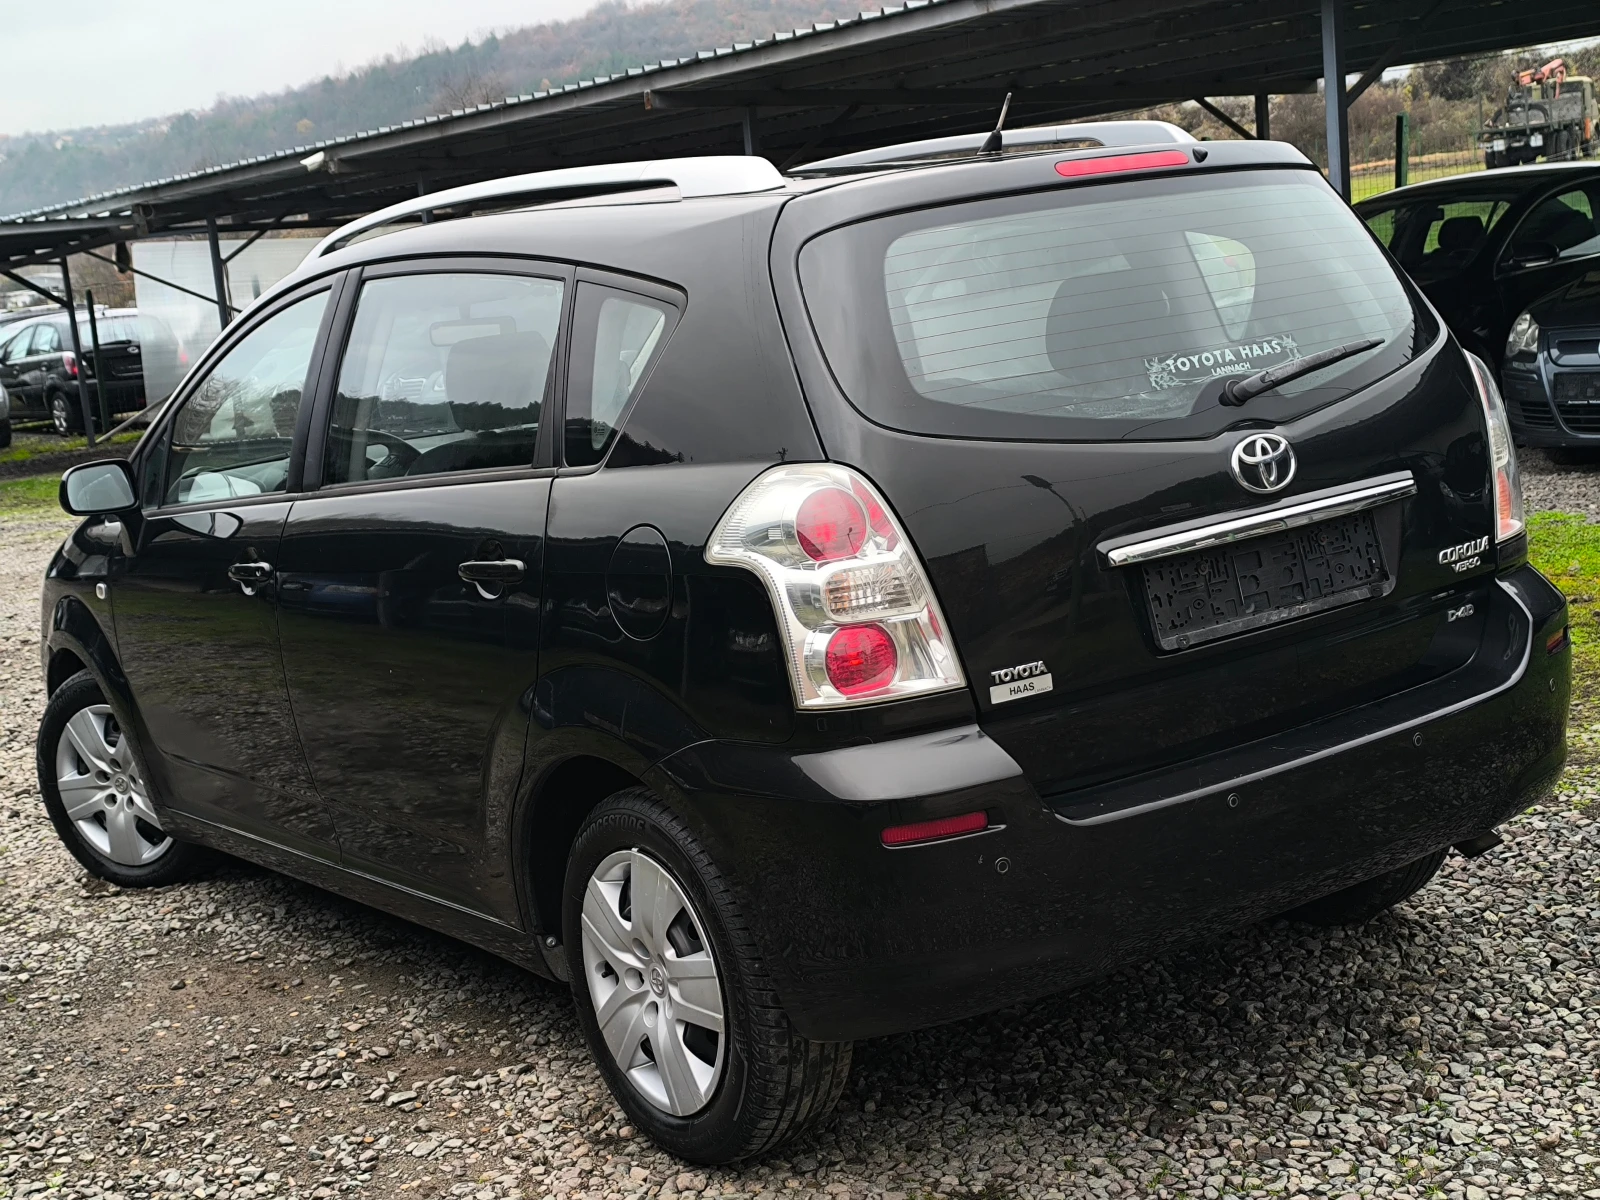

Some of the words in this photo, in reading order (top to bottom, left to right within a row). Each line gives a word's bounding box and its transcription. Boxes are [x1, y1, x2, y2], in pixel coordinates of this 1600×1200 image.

[1166, 348, 1236, 373] TOYOTA
[1239, 340, 1282, 360] HAAS
[1211, 361, 1251, 377] LANNACH
[1438, 535, 1489, 564] COROLLA
[1451, 556, 1481, 573] VERSO
[990, 660, 1048, 684] TOYOTA
[1009, 682, 1035, 696] HAAS
